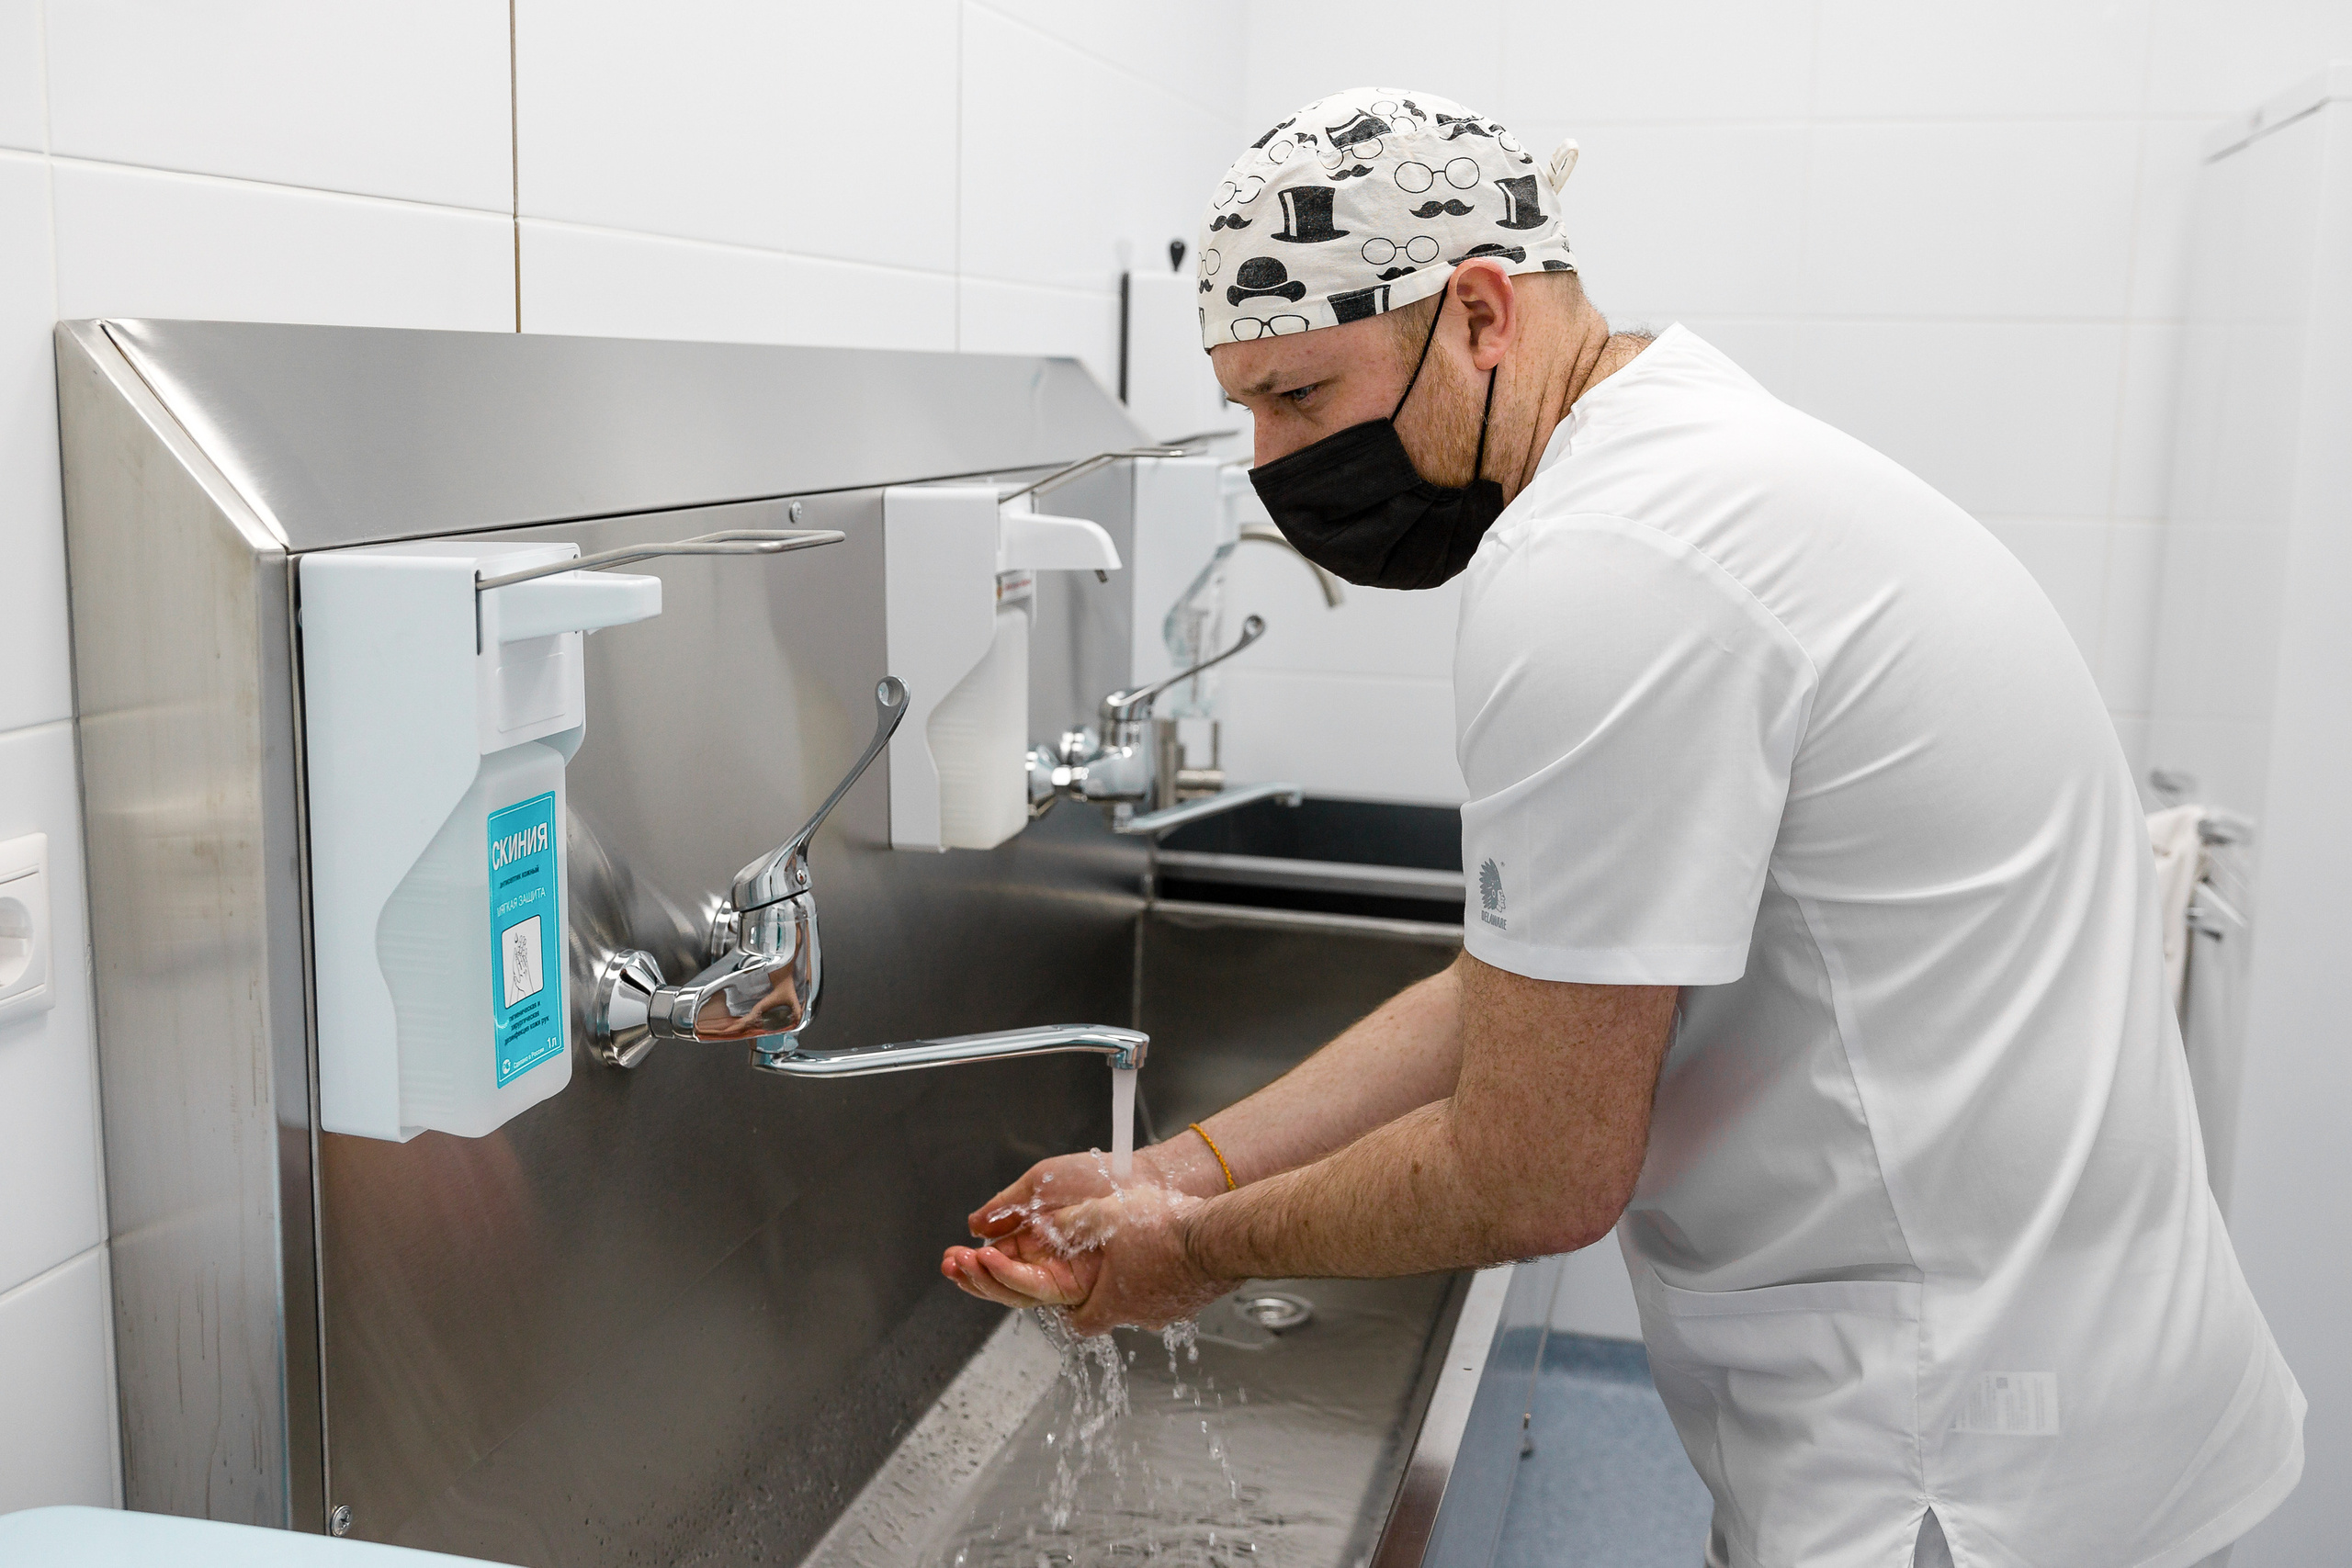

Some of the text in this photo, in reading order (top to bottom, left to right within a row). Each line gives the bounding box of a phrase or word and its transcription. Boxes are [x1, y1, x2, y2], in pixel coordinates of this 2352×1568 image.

[492, 822, 548, 871] СКИНИЯ
[521, 864, 540, 881] кожный
[518, 886, 547, 907] ЗАЩИТА
[1481, 910, 1507, 931] DELAWARE
[530, 1019, 541, 1030] кожи
[541, 1016, 549, 1025] рук
[547, 1036, 558, 1048] 1л
[531, 1047, 545, 1058] России
